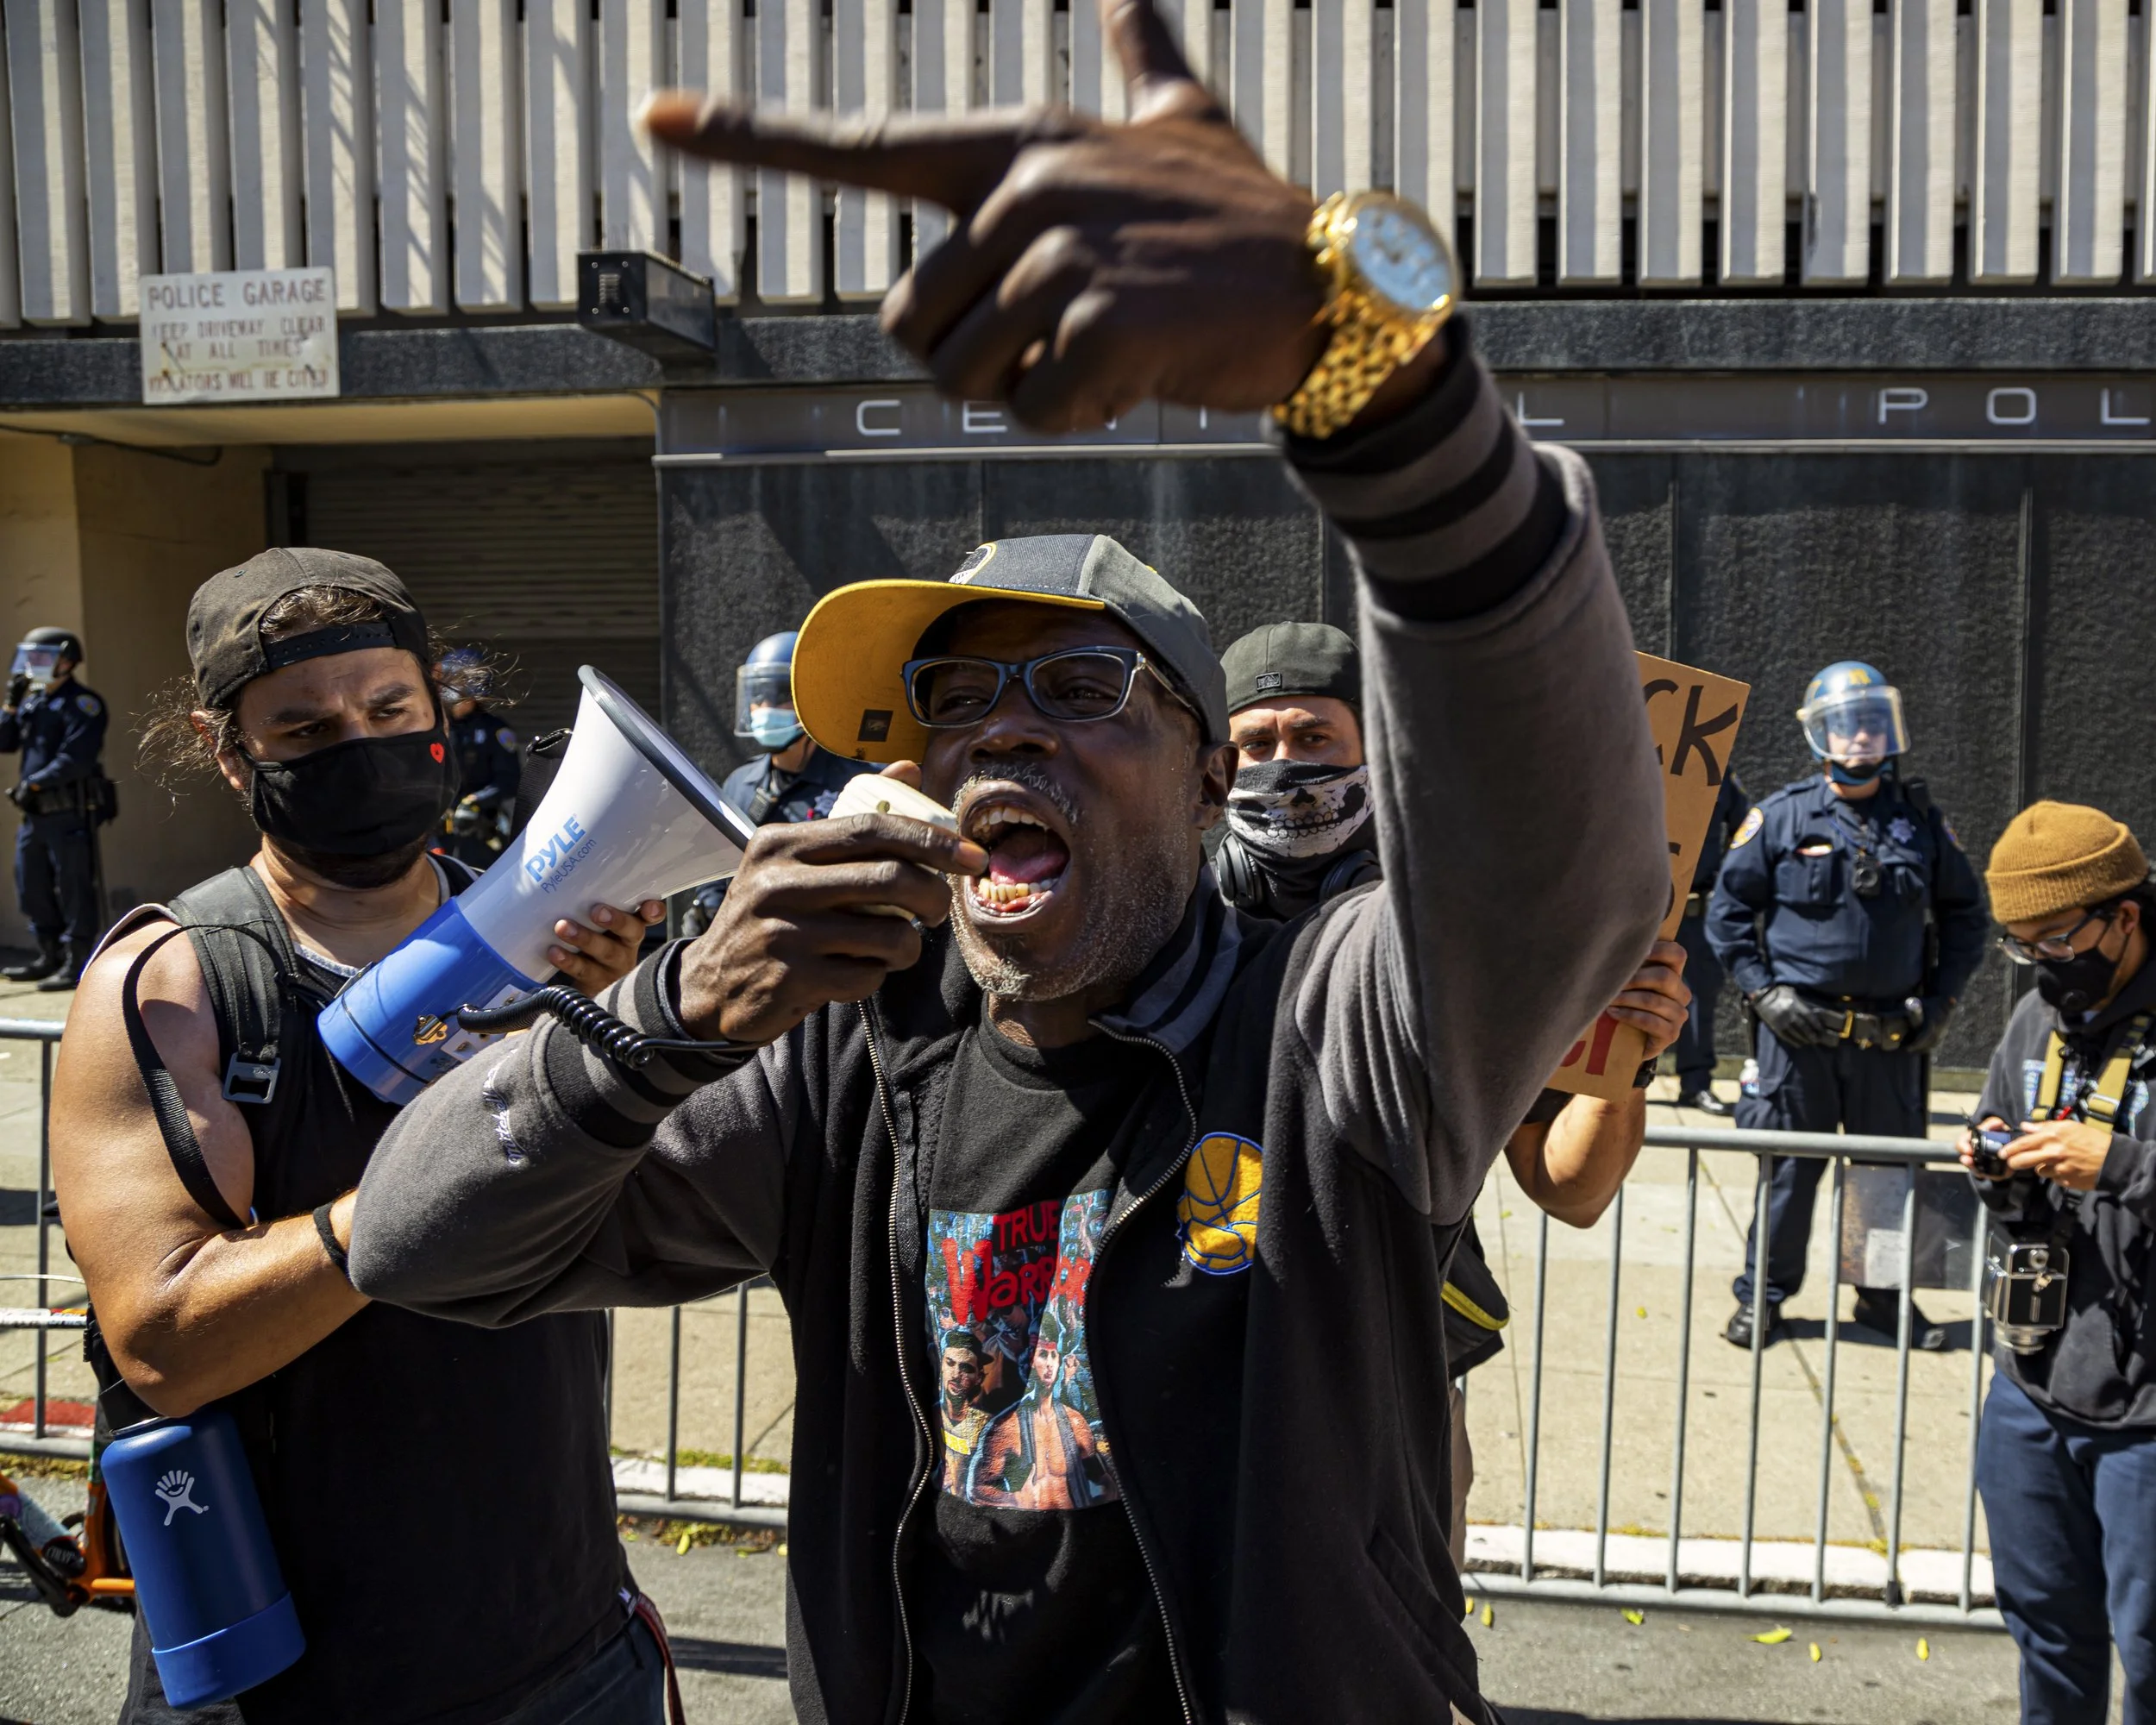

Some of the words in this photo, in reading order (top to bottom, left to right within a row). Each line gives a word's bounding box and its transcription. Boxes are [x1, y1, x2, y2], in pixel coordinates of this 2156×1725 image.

[148, 283, 224, 310] POLICE
[243, 278, 325, 306] GARAGE
[197, 319, 265, 339] DRIVEWAY
[176, 343, 191, 361] AT
[210, 342, 236, 360] ALL
[524, 816, 586, 883] PYLE
[541, 838, 597, 894] PyleUSA.com
[993, 1201, 1060, 1251] TRUE
